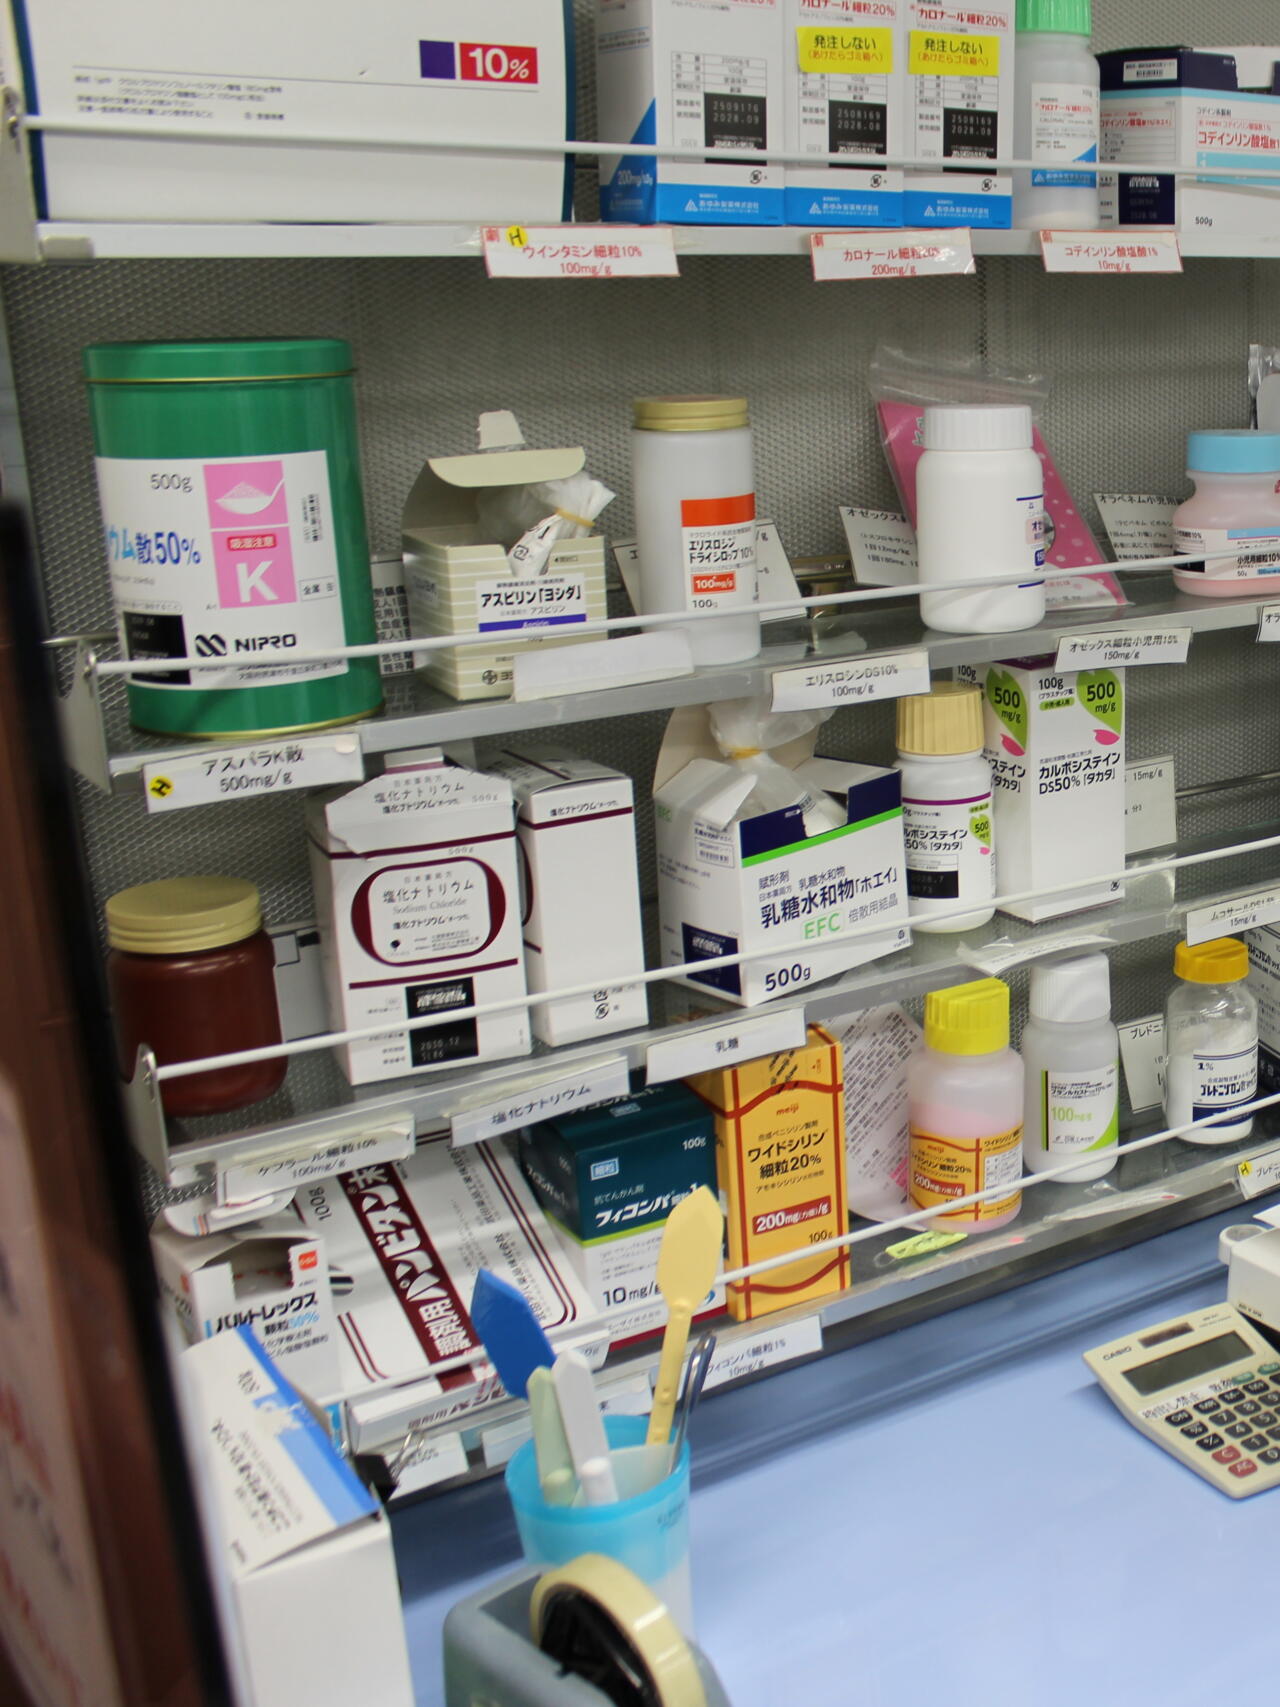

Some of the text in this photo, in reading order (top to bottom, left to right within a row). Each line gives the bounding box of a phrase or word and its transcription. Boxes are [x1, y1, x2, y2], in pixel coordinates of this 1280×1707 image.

[814, 35, 876, 50] 発注しない
[925, 38, 983, 54] 発注しない
[469, 47, 530, 80] 10%
[1195, 216, 1213, 227] 500g
[508, 228, 523, 246] H
[522, 245, 643, 259] ウインタミン細粒10%
[560, 263, 612, 275] 100mg/g
[872, 262, 917, 276] 200mg/g
[151, 474, 192, 493] 500g
[689, 536, 737, 551] エリスロシン
[236, 561, 278, 602] K
[481, 585, 581, 607] アスピリン「ヨシダ」
[235, 633, 297, 652] NIPRO
[1104, 650, 1140, 661] 150mg/g
[806, 663, 898, 687] エリスロシンDS10%
[957, 664, 977, 681] 100g
[831, 684, 875, 698] 100mg/g
[1038, 676, 1064, 691] 100g
[1086, 681, 1115, 702] 500
[994, 686, 1021, 709] 500
[1095, 700, 1116, 713] mg/g
[1001, 709, 1021, 724] mg/g
[202, 745, 304, 776] アスパラK散
[1039, 752, 1121, 779] カルボシステイン
[220, 768, 293, 793] 500mg/g
[1133, 767, 1163, 781] 15mg/g
[151, 778, 172, 797] H
[374, 782, 465, 804] 塩化ナトリウム
[904, 828, 968, 841] ルボシステイン
[975, 820, 989, 834] 500
[383, 880, 475, 904] 塩化ナトリウム
[761, 866, 898, 929] 乳糖水和物「ホエイ」
[803, 912, 842, 940] EFC
[1230, 914, 1257, 927] 15mg/g
[765, 963, 812, 993] 500g
[714, 1038, 740, 1054] 乳糖
[1198, 1063, 1214, 1071] 1%
[490, 1081, 591, 1126] 塩化ナトリウム
[776, 1104, 800, 1116] meiji
[683, 1137, 706, 1151] 100g
[748, 1131, 826, 1163] ワイドシリン
[759, 1154, 821, 1180] 細粒20%
[309, 1187, 332, 1222] 100g
[809, 1230, 833, 1243] 100g
[1102, 1345, 1132, 1361] CASIO
